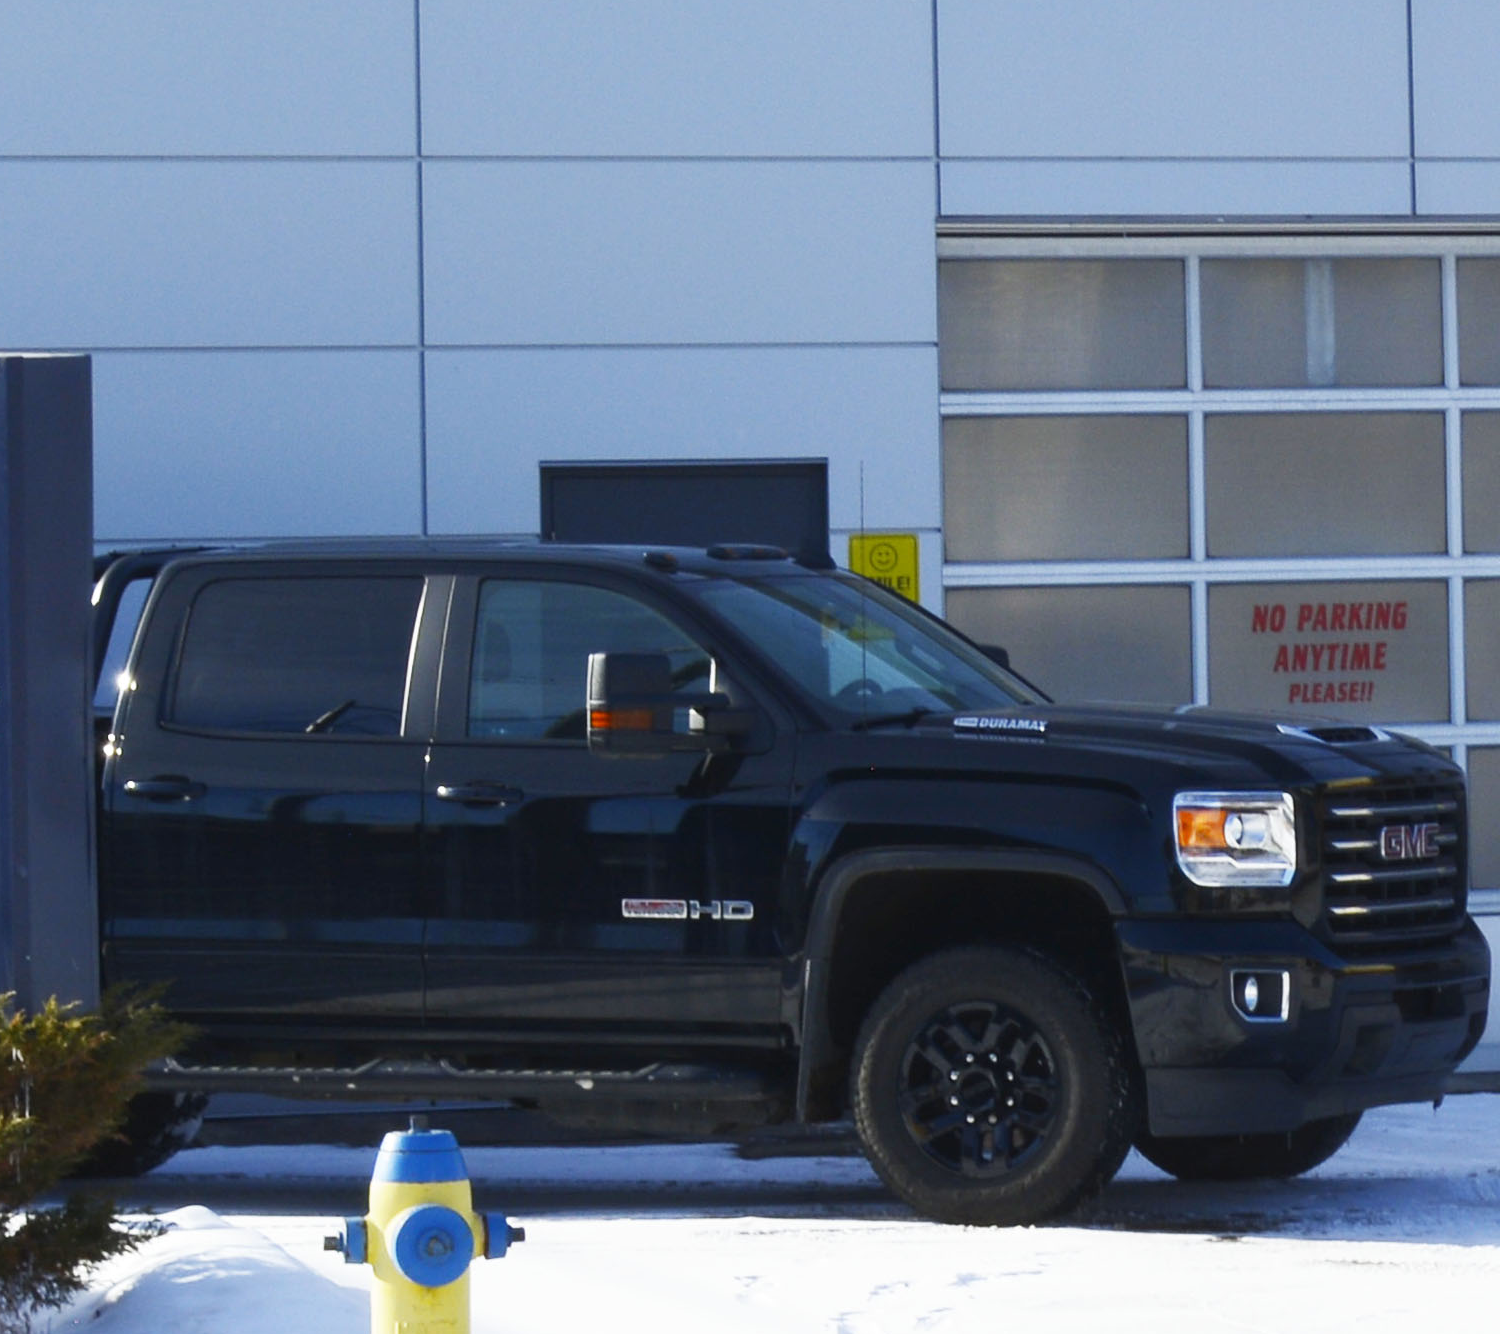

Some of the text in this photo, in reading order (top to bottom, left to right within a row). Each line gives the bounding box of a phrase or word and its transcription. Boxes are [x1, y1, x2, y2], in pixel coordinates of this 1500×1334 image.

[1252, 601, 1408, 633] NO PARKING
[1273, 641, 1388, 673] ANYTIME
[1288, 681, 1374, 704] PLEASE!!
[1380, 822, 1440, 860] GMC
[689, 899, 754, 919] HD
